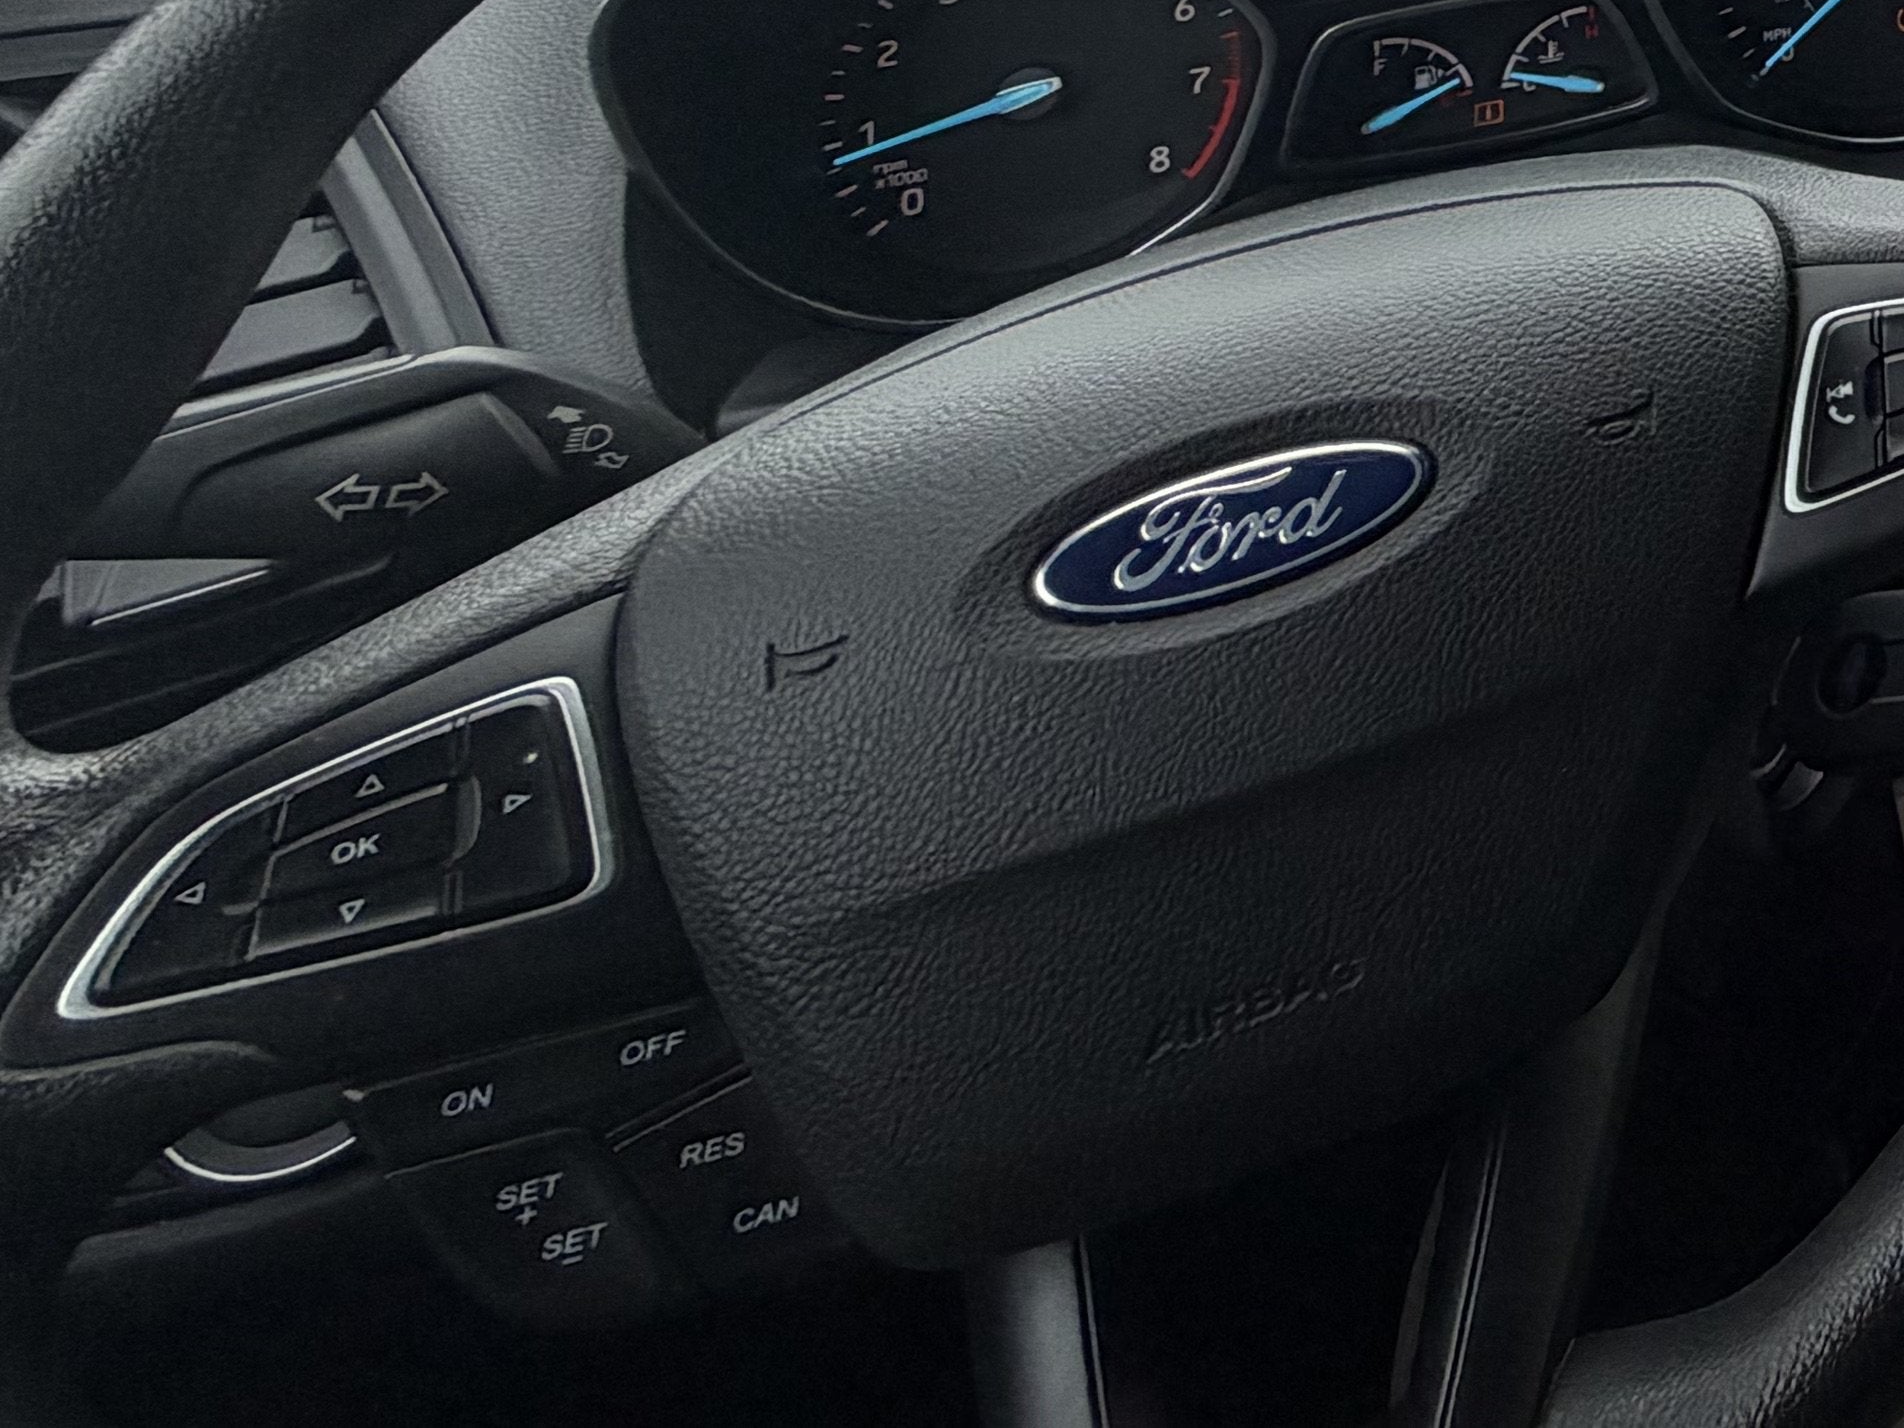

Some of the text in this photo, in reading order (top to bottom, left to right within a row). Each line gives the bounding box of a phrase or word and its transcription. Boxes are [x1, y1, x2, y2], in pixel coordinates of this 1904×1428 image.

[1762, 26, 1793, 43] MPH
[877, 40, 899, 68] 2
[1373, 58, 1389, 76] F
[1188, 67, 1211, 94] 7
[857, 120, 876, 146] 1
[1149, 146, 1171, 173] 8
[900, 187, 925, 216] 0
[1113, 465, 1348, 593] Ford
[330, 832, 381, 865] OK
[1145, 956, 1367, 1066] AIRBAG
[620, 1029, 687, 1066] OFF
[440, 1083, 494, 1117] ON
[679, 1131, 746, 1169] RES
[495, 1171, 565, 1211] SET
[732, 1195, 800, 1234] CAN
[540, 1221, 610, 1261] SET
